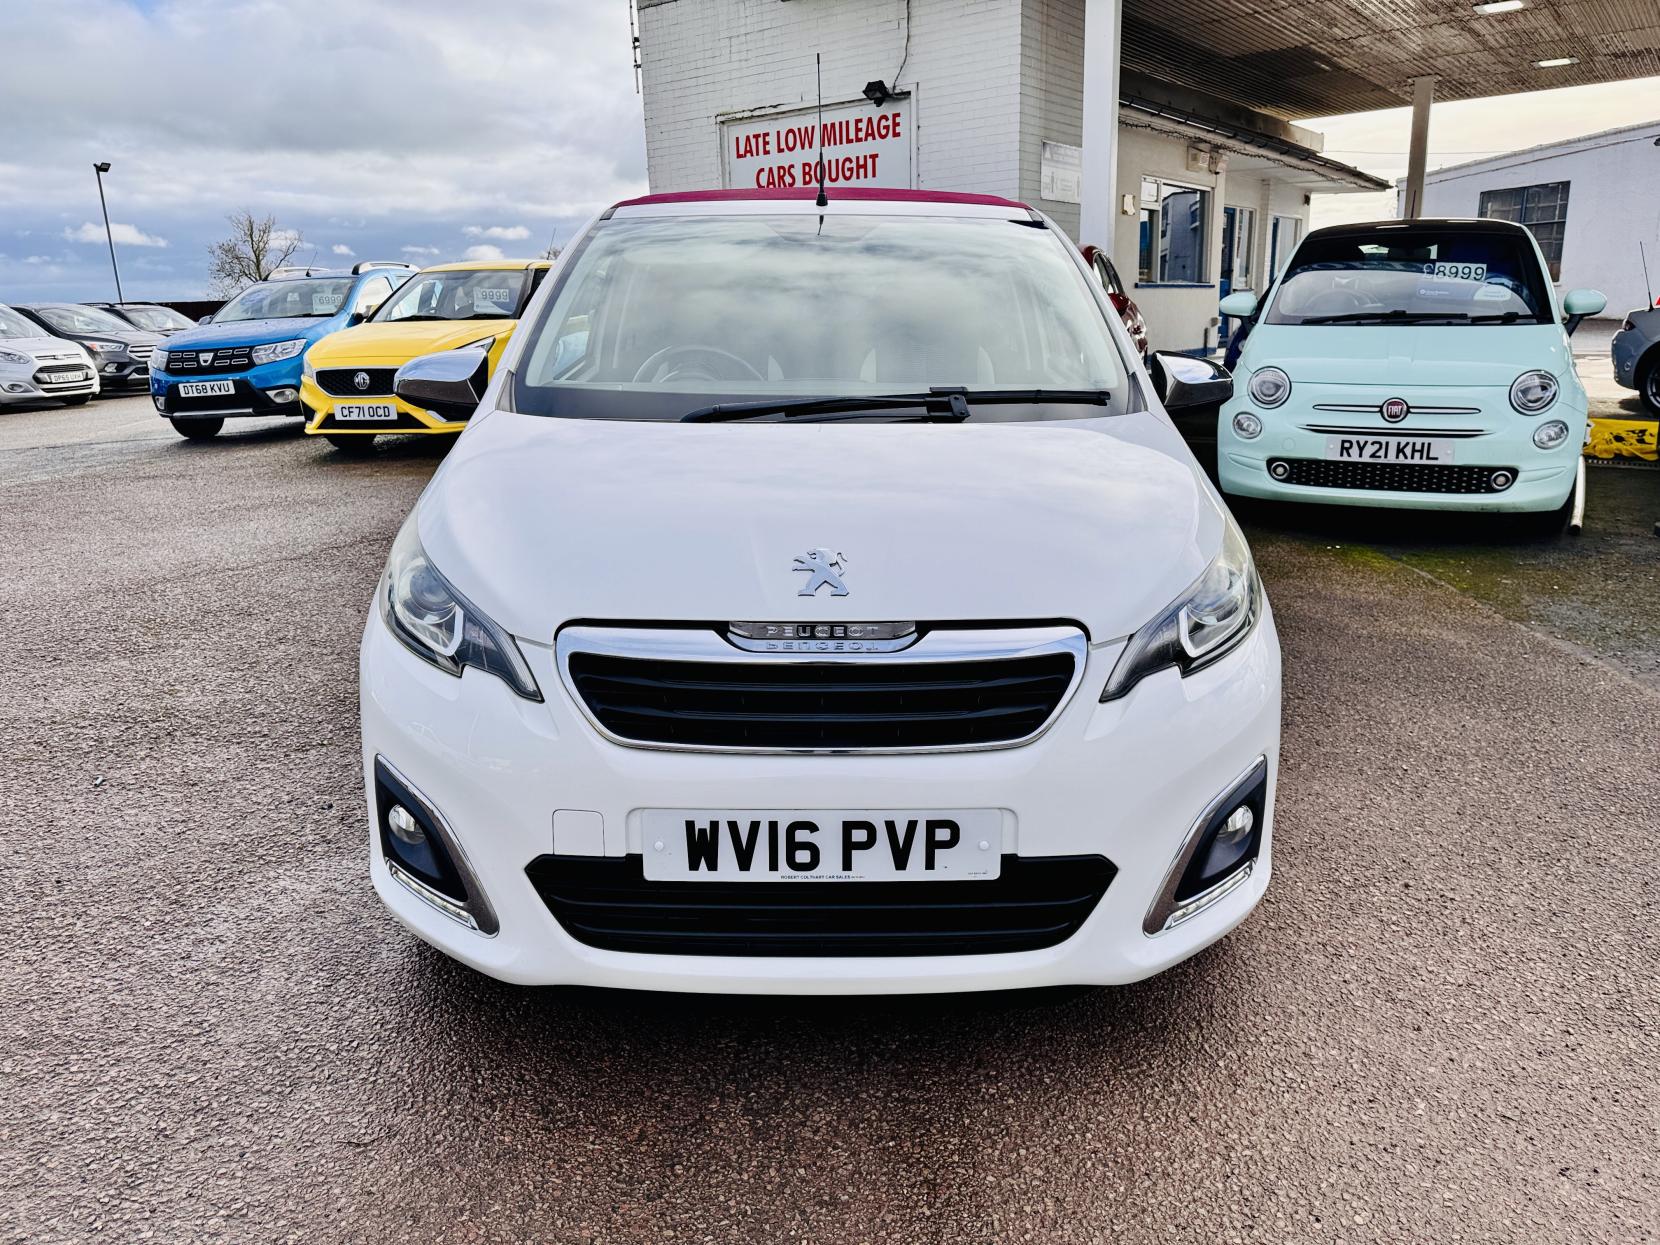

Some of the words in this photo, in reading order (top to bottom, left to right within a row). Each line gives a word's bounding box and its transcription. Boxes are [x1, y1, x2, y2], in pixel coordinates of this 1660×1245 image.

[735, 131, 771, 159] LATE
[776, 125, 816, 154] LOW
[820, 111, 901, 148] MILEAGE
[755, 163, 796, 188] CARS
[801, 153, 879, 186] BOUGHT
[182, 384, 208, 395] DT68
[209, 382, 230, 394] KVU
[340, 405, 366, 418] CF71
[367, 405, 391, 418] OCD
[1387, 405, 1404, 416] FIAT
[1339, 438, 1390, 459] RY21
[1395, 441, 1439, 461] KHL
[766, 625, 879, 637] PEUGEOT
[685, 819, 821, 872] WV16
[841, 819, 961, 871] PVP
